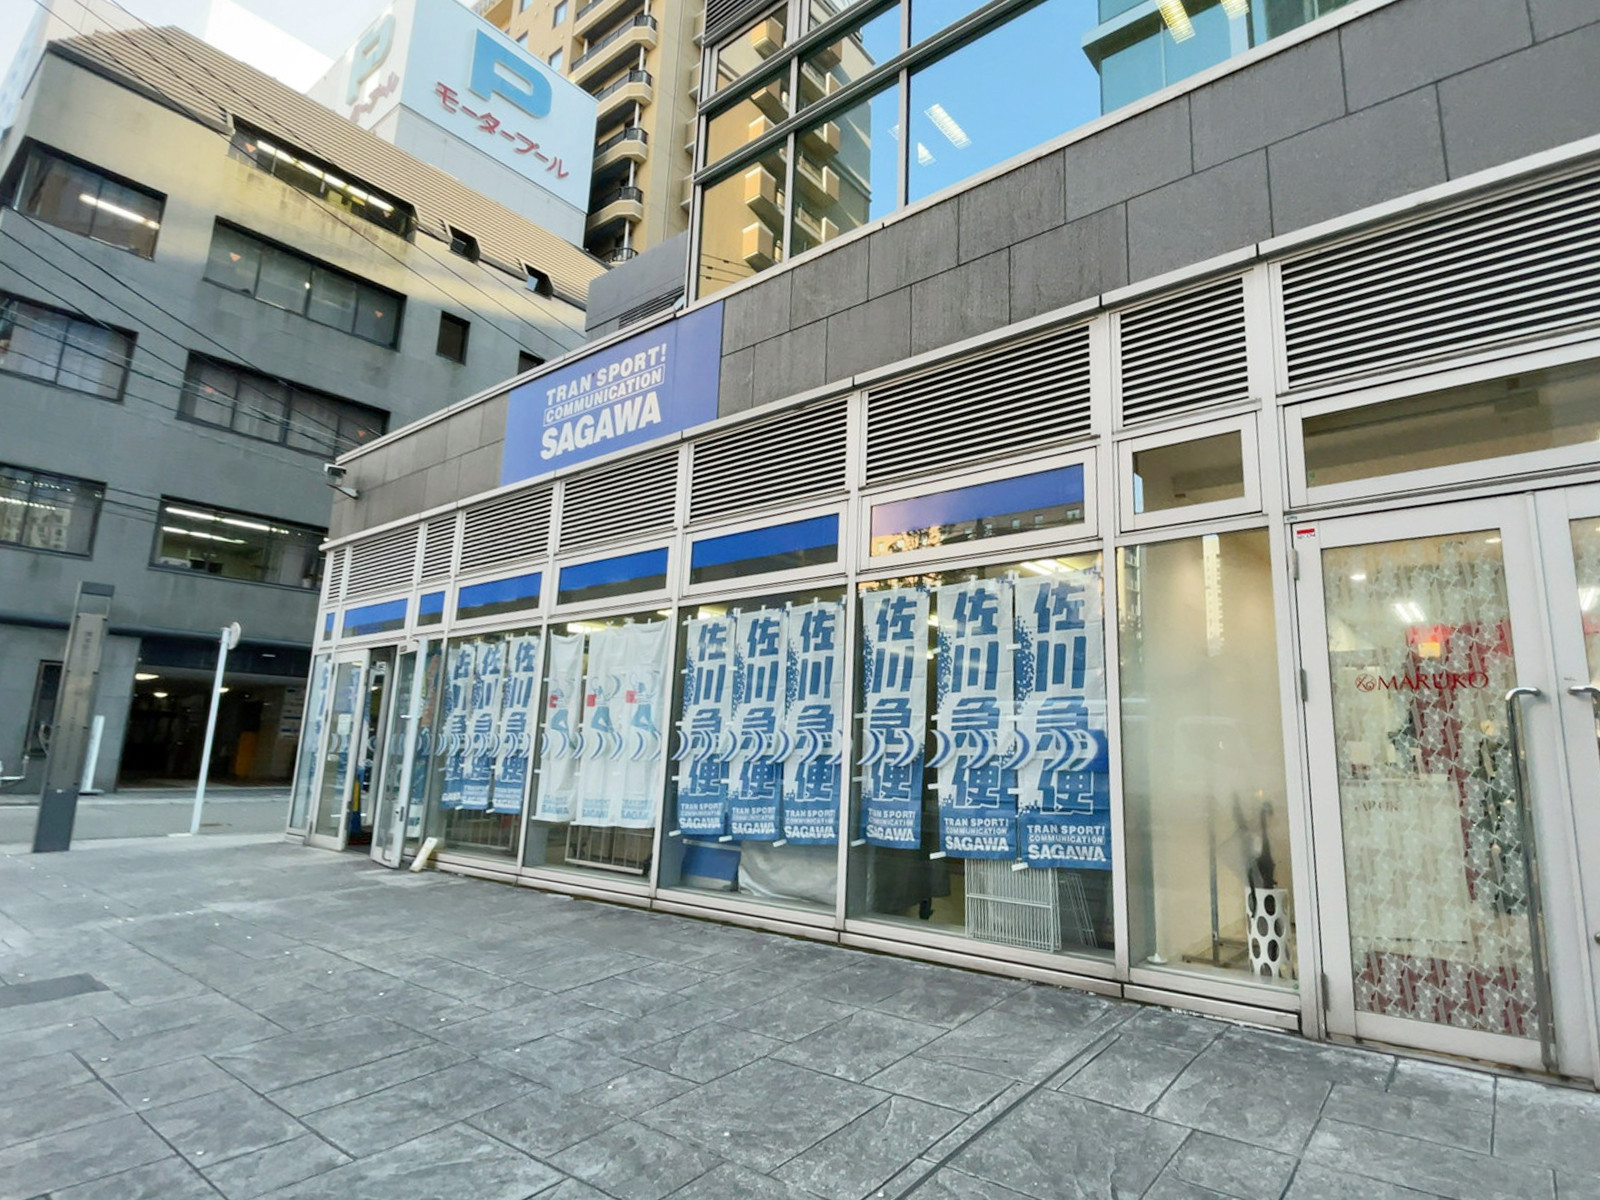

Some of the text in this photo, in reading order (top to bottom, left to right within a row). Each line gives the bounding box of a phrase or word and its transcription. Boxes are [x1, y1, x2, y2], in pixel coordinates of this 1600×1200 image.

[469, 29, 552, 119] P
[434, 81, 570, 179] モータープール
[540, 391, 661, 460] SAGAWA
[546, 367, 662, 423] COMMUNICATION
[688, 622, 728, 796] 佐川急便
[737, 616, 781, 800] 佐川急便
[794, 608, 836, 802] 佐川急便
[950, 587, 1000, 809] 佐川急便
[1033, 580, 1092, 815] 佐川急便
[1378, 671, 1489, 691] MARUKO
[679, 817, 721, 829] SAGAWA
[731, 821, 776, 834] SAGAWA
[784, 825, 836, 838] SAGAWA
[945, 835, 1010, 852] SAGAWA
[1027, 843, 1107, 862] SAGAWA
[1028, 833, 1104, 845] COMMUNICATION
